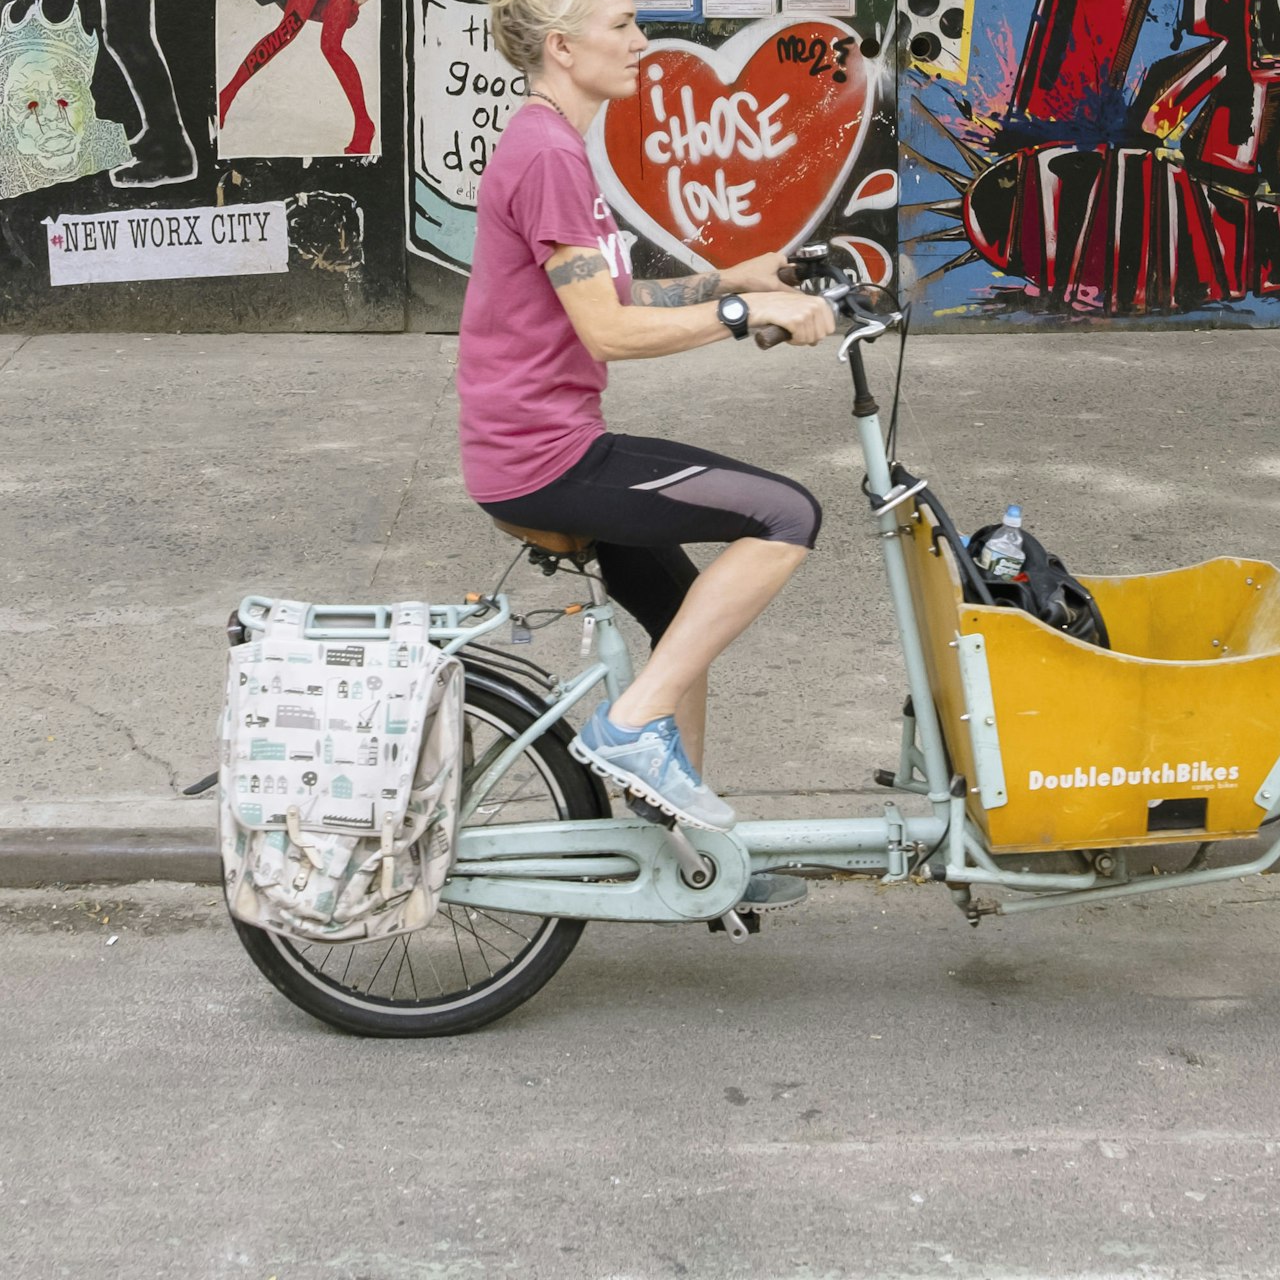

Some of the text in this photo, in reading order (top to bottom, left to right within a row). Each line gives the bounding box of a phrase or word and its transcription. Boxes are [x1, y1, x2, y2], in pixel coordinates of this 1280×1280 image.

[50, 211, 271, 252] #NEW WORX CITY
[1028, 761, 1240, 790] DoubleDutchBikes
